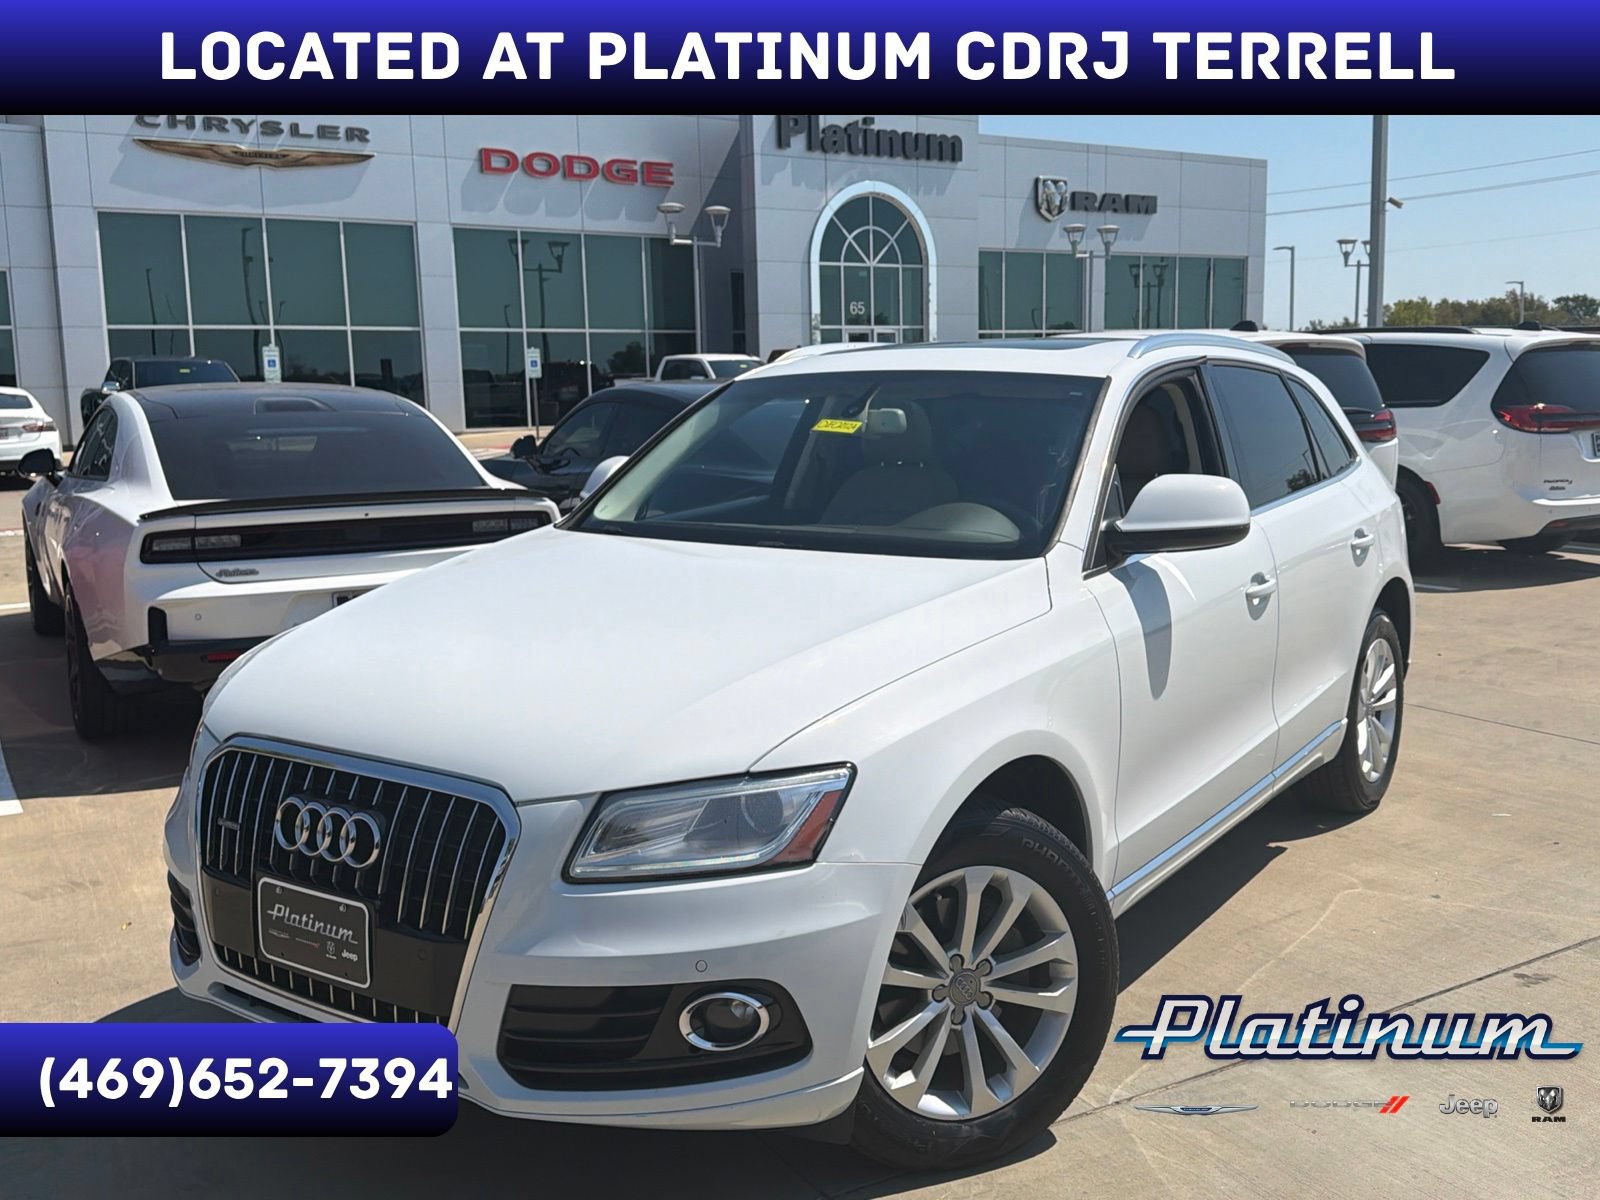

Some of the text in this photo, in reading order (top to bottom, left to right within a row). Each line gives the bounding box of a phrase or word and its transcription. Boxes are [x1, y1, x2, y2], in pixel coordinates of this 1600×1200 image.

[135, 115, 370, 143] CHRYSLER
[776, 115, 963, 163] Platinum
[480, 147, 675, 188] DODGE
[1070, 191, 1158, 215] RAM
[849, 301, 865, 315] 65
[266, 903, 359, 945] Platinum
